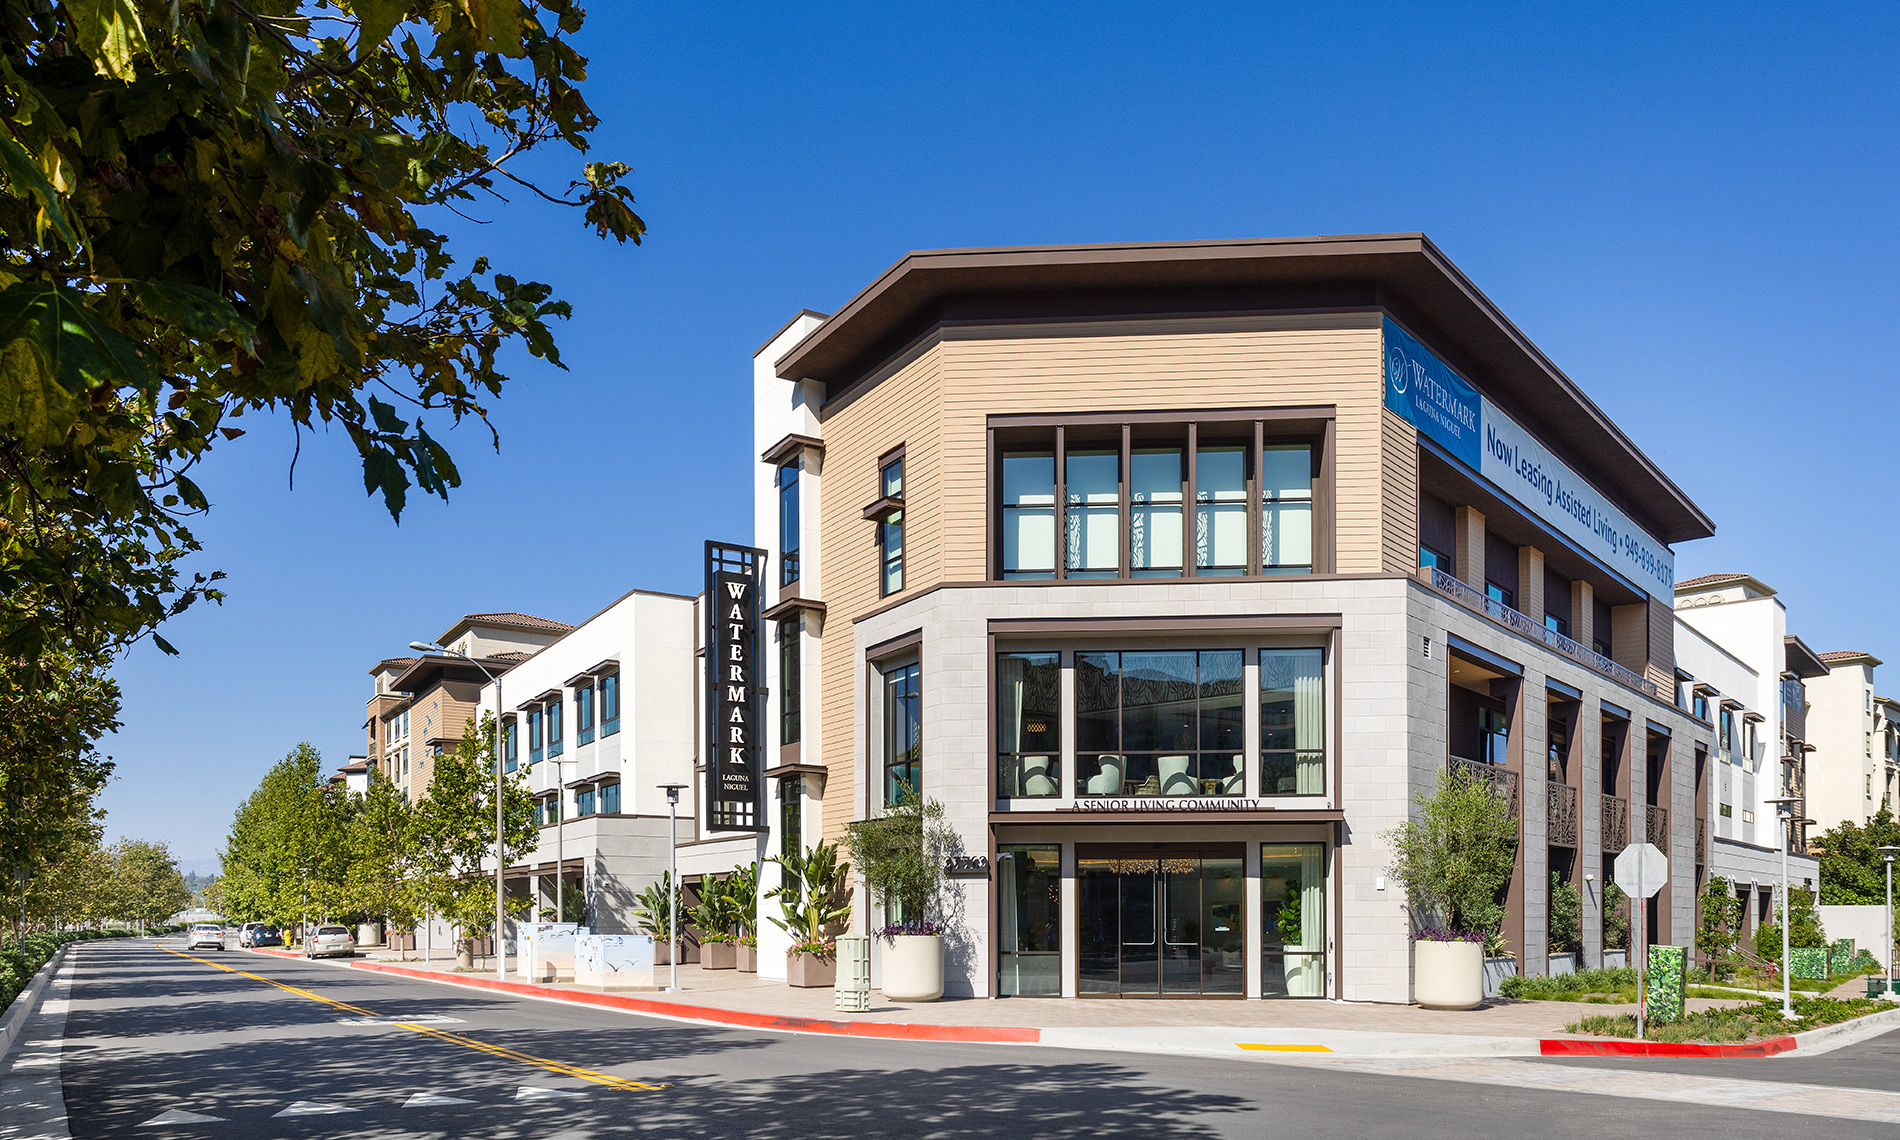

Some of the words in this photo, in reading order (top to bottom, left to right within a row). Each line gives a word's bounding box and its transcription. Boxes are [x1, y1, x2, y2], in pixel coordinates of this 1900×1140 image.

[1411, 358, 1476, 433] WATERMARK
[1415, 394, 1440, 423] LAGUNA
[1440, 413, 1462, 440] NIGUEL
[1487, 423, 1513, 468] Now
[1514, 445, 1553, 506] Leasing
[1555, 479, 1592, 530] Assisted
[1593, 508, 1617, 555] Living
[1624, 533, 1673, 589] 949-899-8175
[725, 581, 747, 765] WATERMARK
[722, 773, 750, 782] LAGUNA
[723, 782, 749, 791] NIGUEL
[1072, 800, 1081, 813] A
[1083, 800, 1130, 813] SENIOR
[1133, 800, 1175, 812] LIVING
[1179, 799, 1260, 812] COMMUNITY
